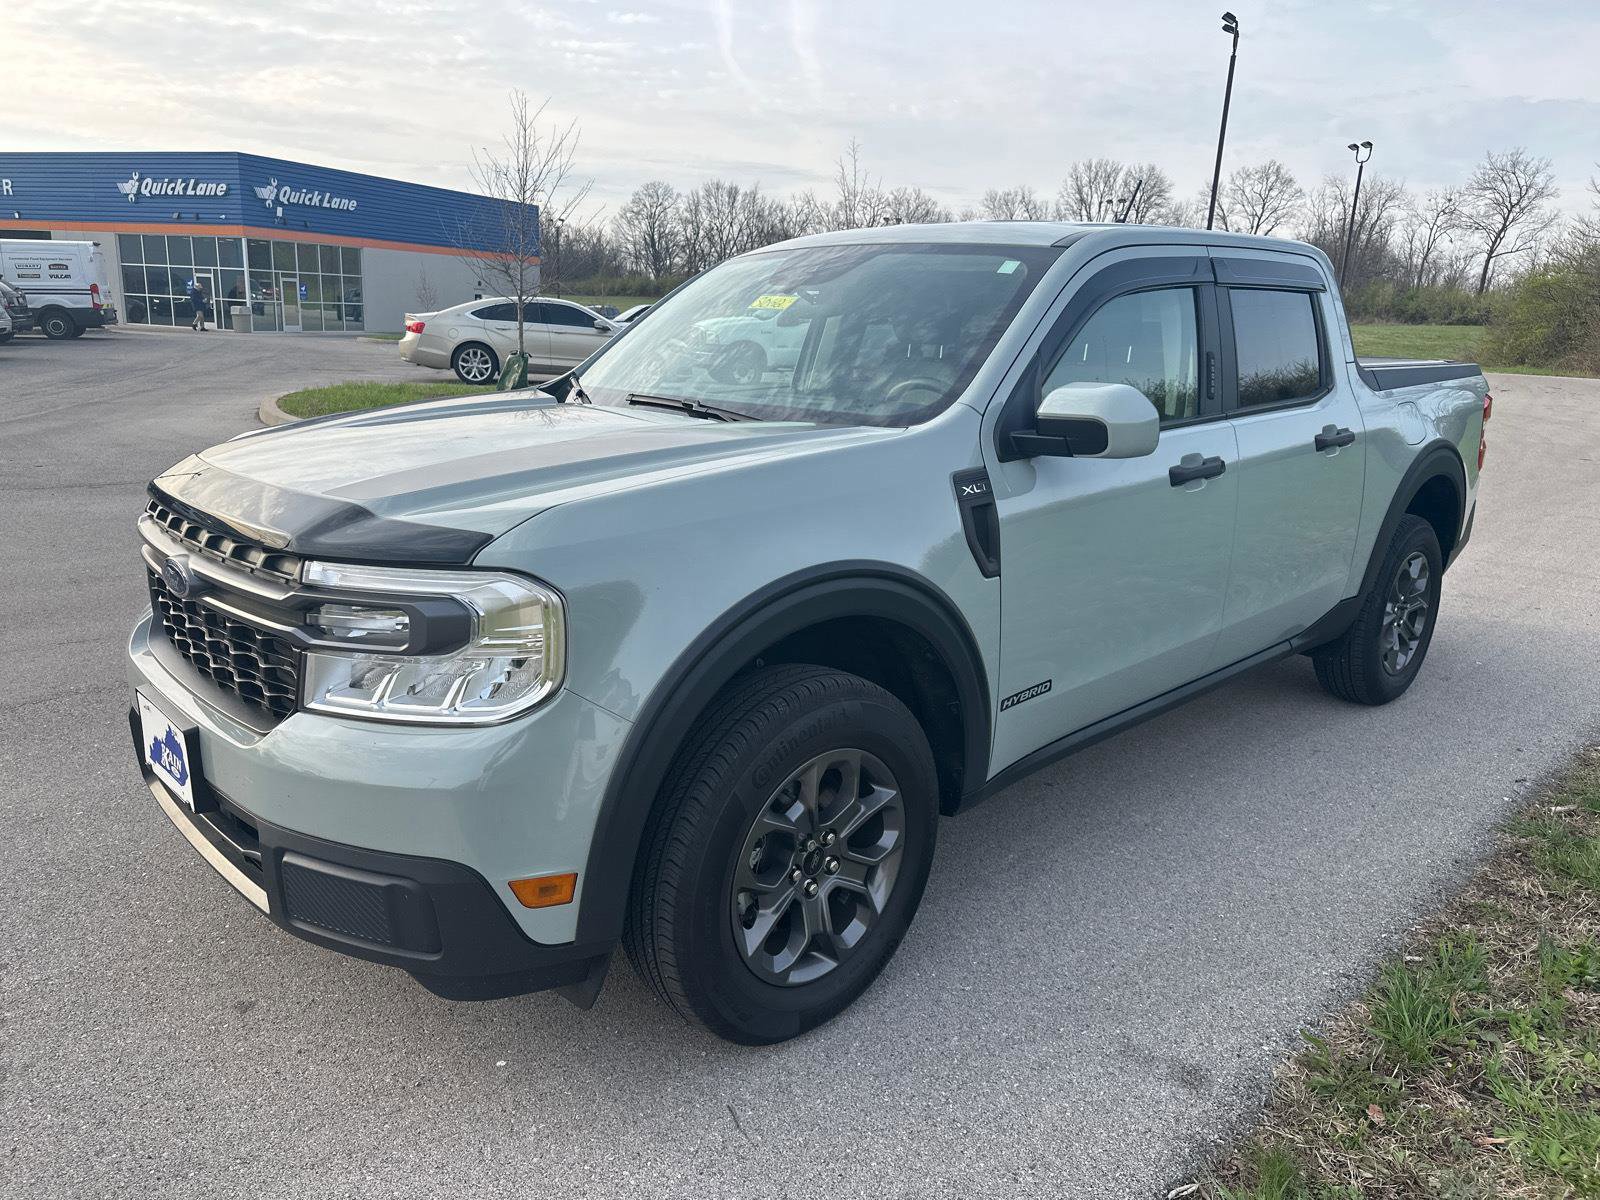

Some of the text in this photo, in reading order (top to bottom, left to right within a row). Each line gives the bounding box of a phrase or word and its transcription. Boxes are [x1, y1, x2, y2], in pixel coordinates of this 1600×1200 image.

[2, 178, 13, 196] R
[140, 177, 227, 197] Quick Lane
[279, 185, 357, 211] Quick Lane
[1002, 682, 1050, 709] HYBRID
